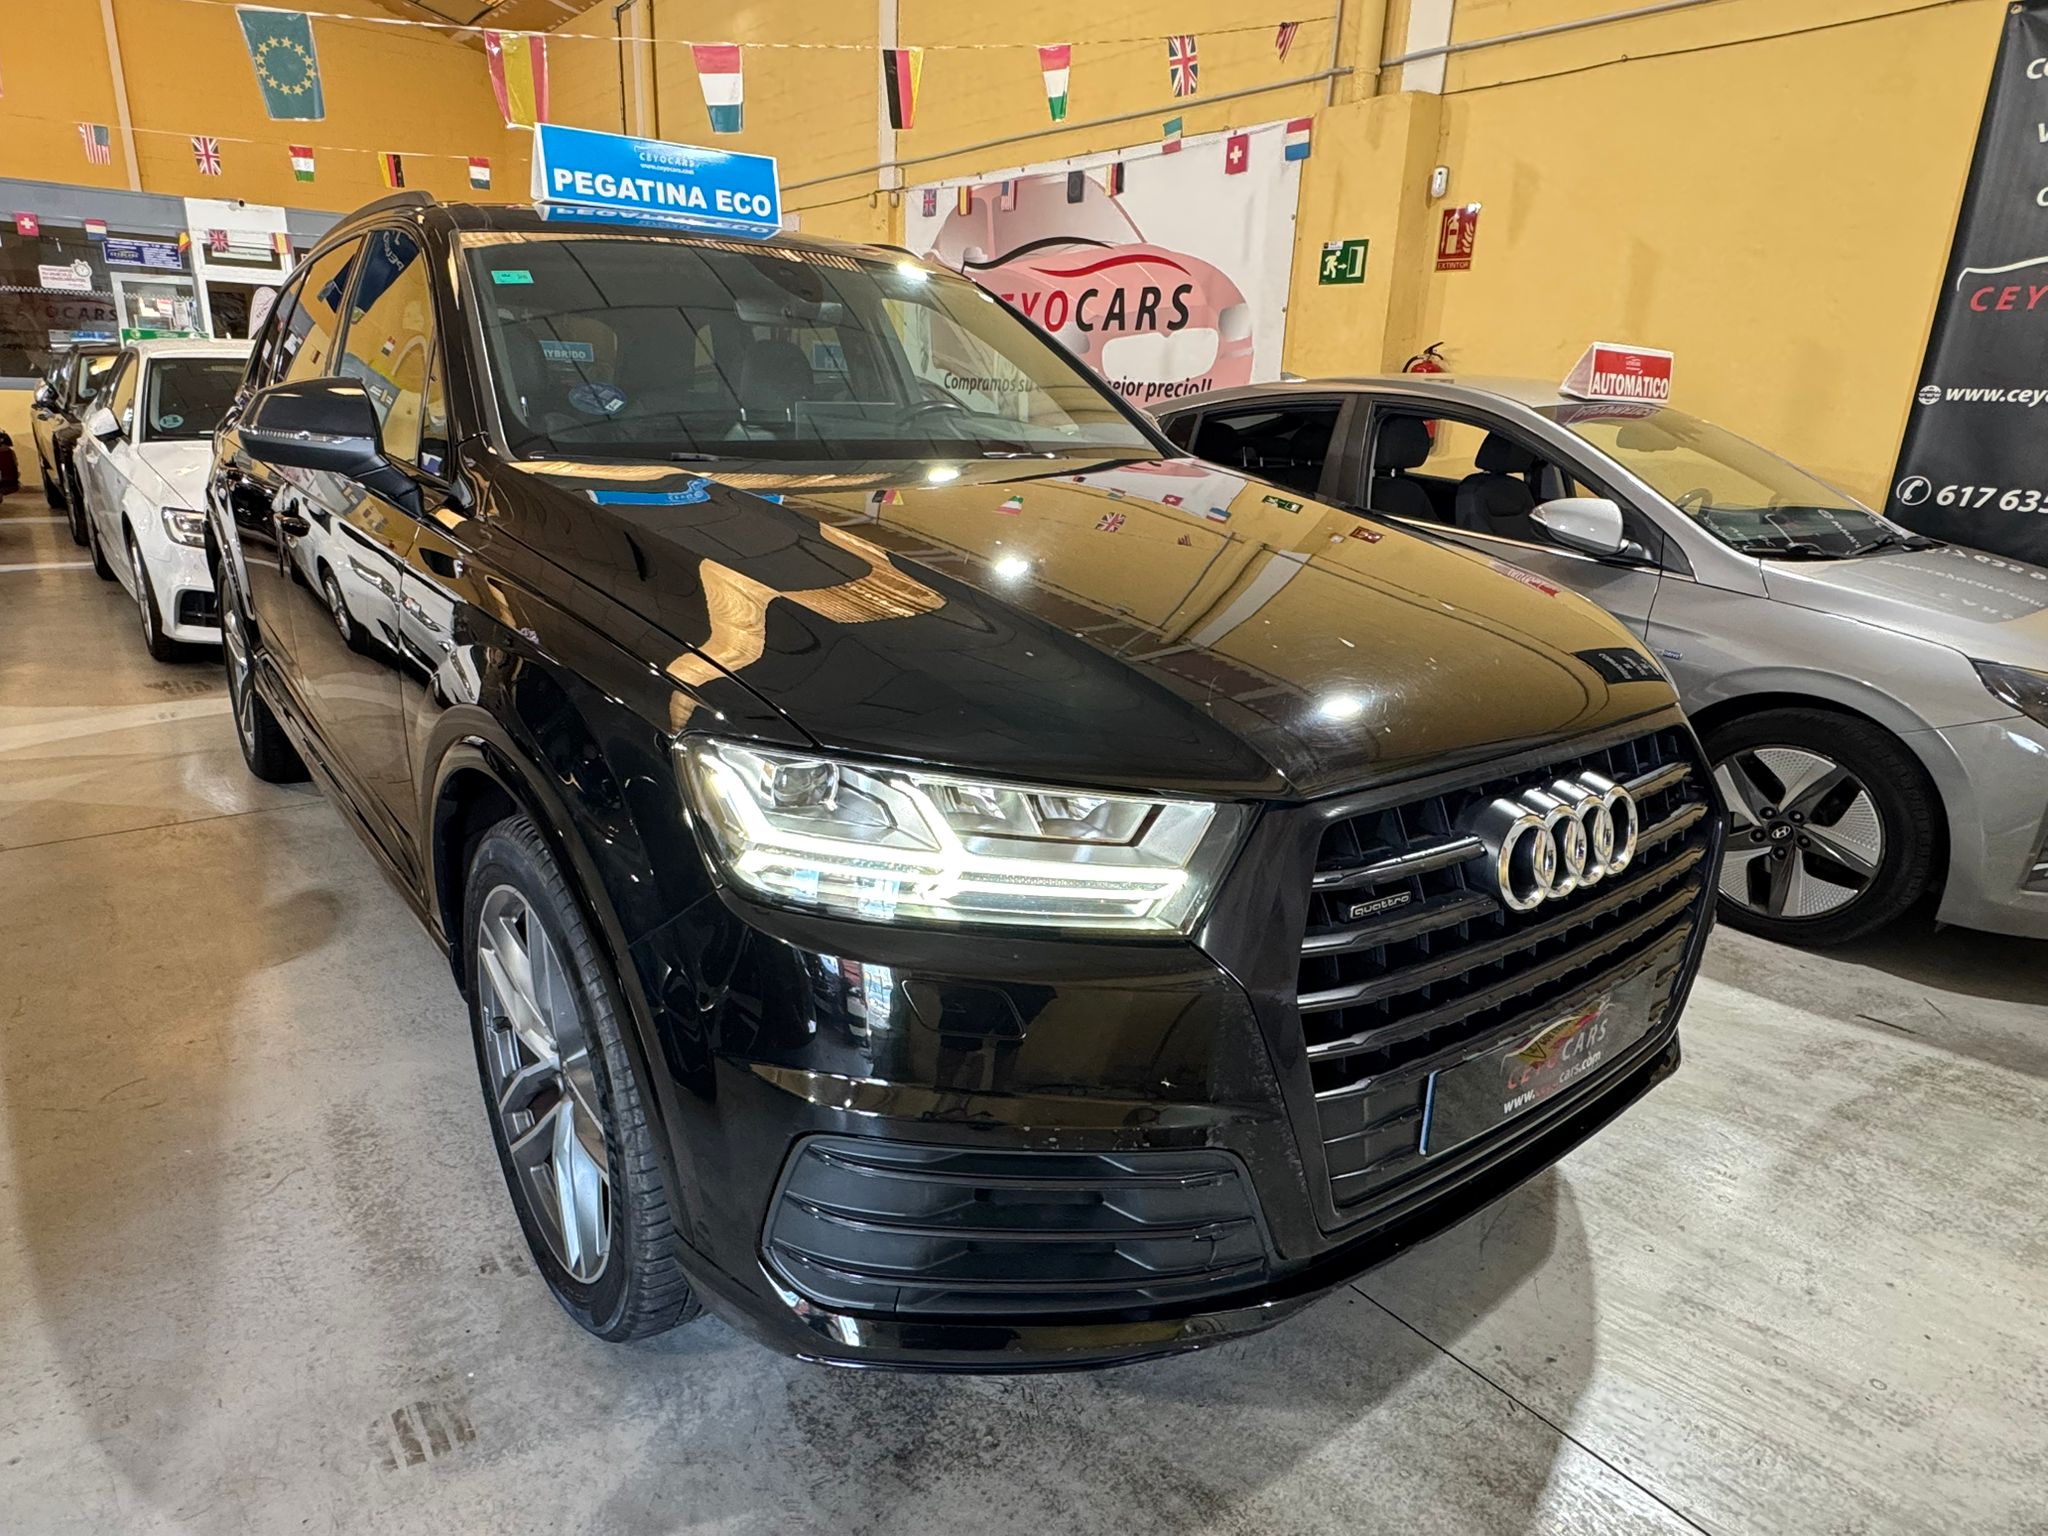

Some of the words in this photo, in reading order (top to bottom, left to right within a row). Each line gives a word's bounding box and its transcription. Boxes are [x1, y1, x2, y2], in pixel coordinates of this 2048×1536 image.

[553, 168, 708, 209] PEGATINA
[716, 189, 771, 217] ECO
[1437, 261, 1470, 269] EXTINTOR
[1000, 283, 1192, 332] YOCARS
[944, 372, 1017, 395] Compramos
[1107, 376, 1144, 397] ejor
[1591, 370, 1669, 398] AUTOMÁTICO
[1936, 485, 1997, 509] 617
[1354, 895, 1409, 916] quattro
[1503, 1051, 1602, 1114] www.cars.com
